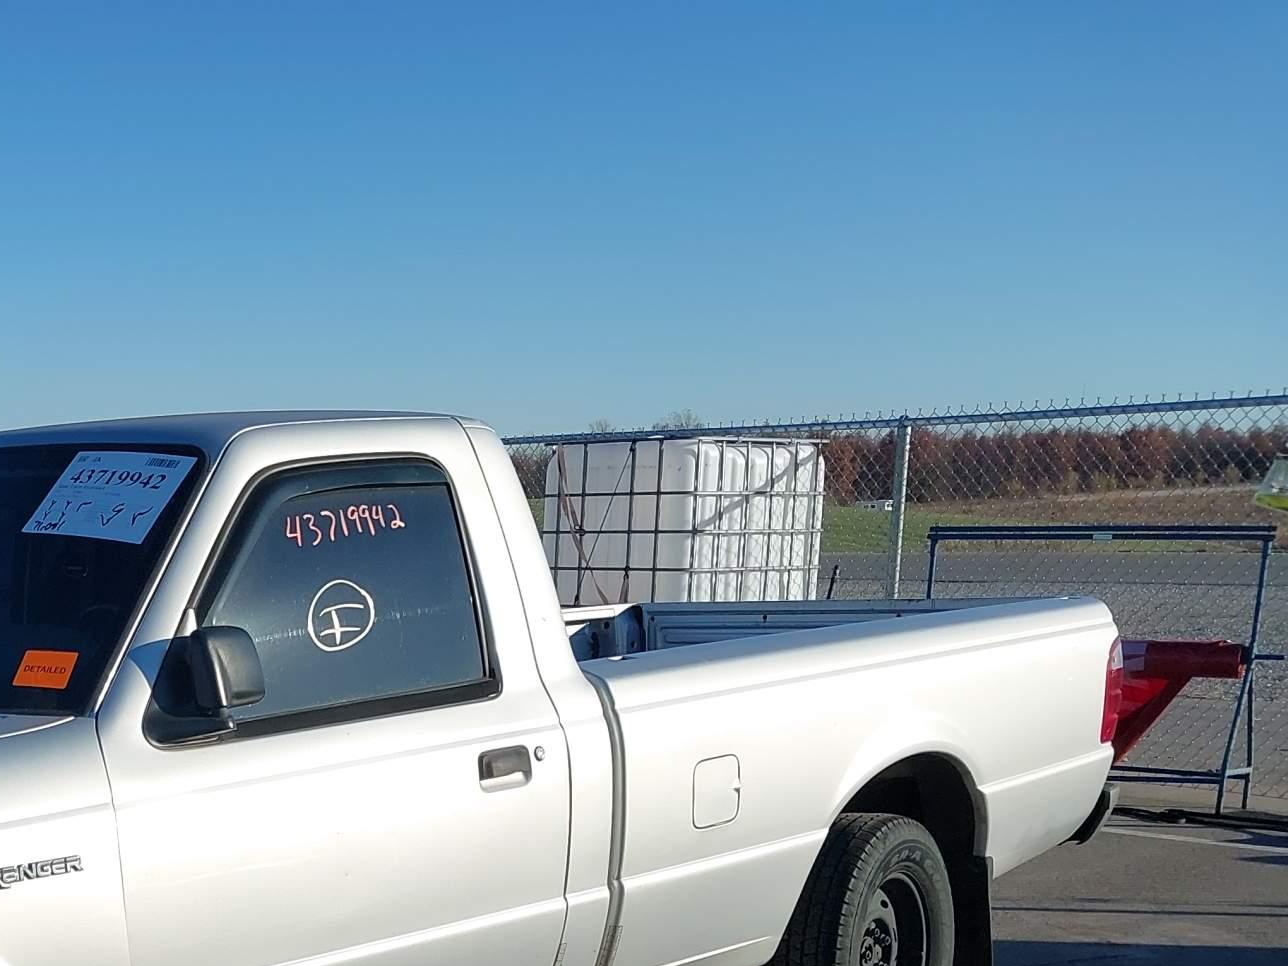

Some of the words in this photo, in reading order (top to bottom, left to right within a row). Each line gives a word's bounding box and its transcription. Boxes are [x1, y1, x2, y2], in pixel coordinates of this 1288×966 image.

[70, 468, 168, 490] 43719942
[285, 504, 406, 547] 43719942
[23, 664, 67, 675] DETAILED
